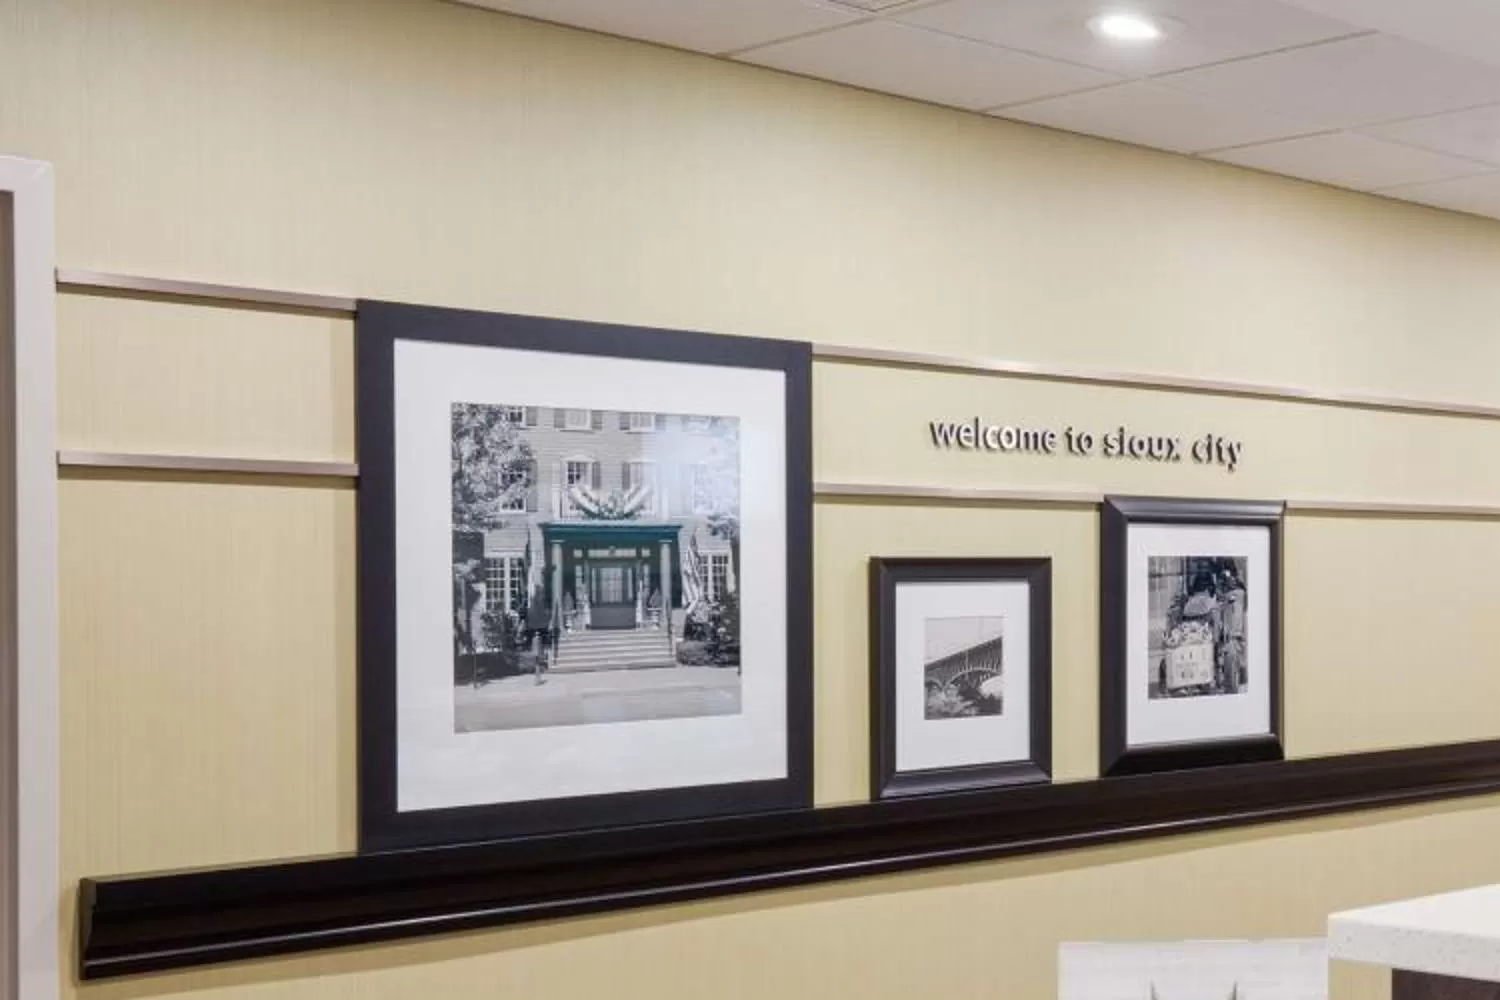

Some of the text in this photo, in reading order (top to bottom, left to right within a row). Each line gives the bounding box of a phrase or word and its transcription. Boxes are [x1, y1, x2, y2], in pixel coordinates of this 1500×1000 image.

[929, 415, 1242, 473] welcome to sioux city
